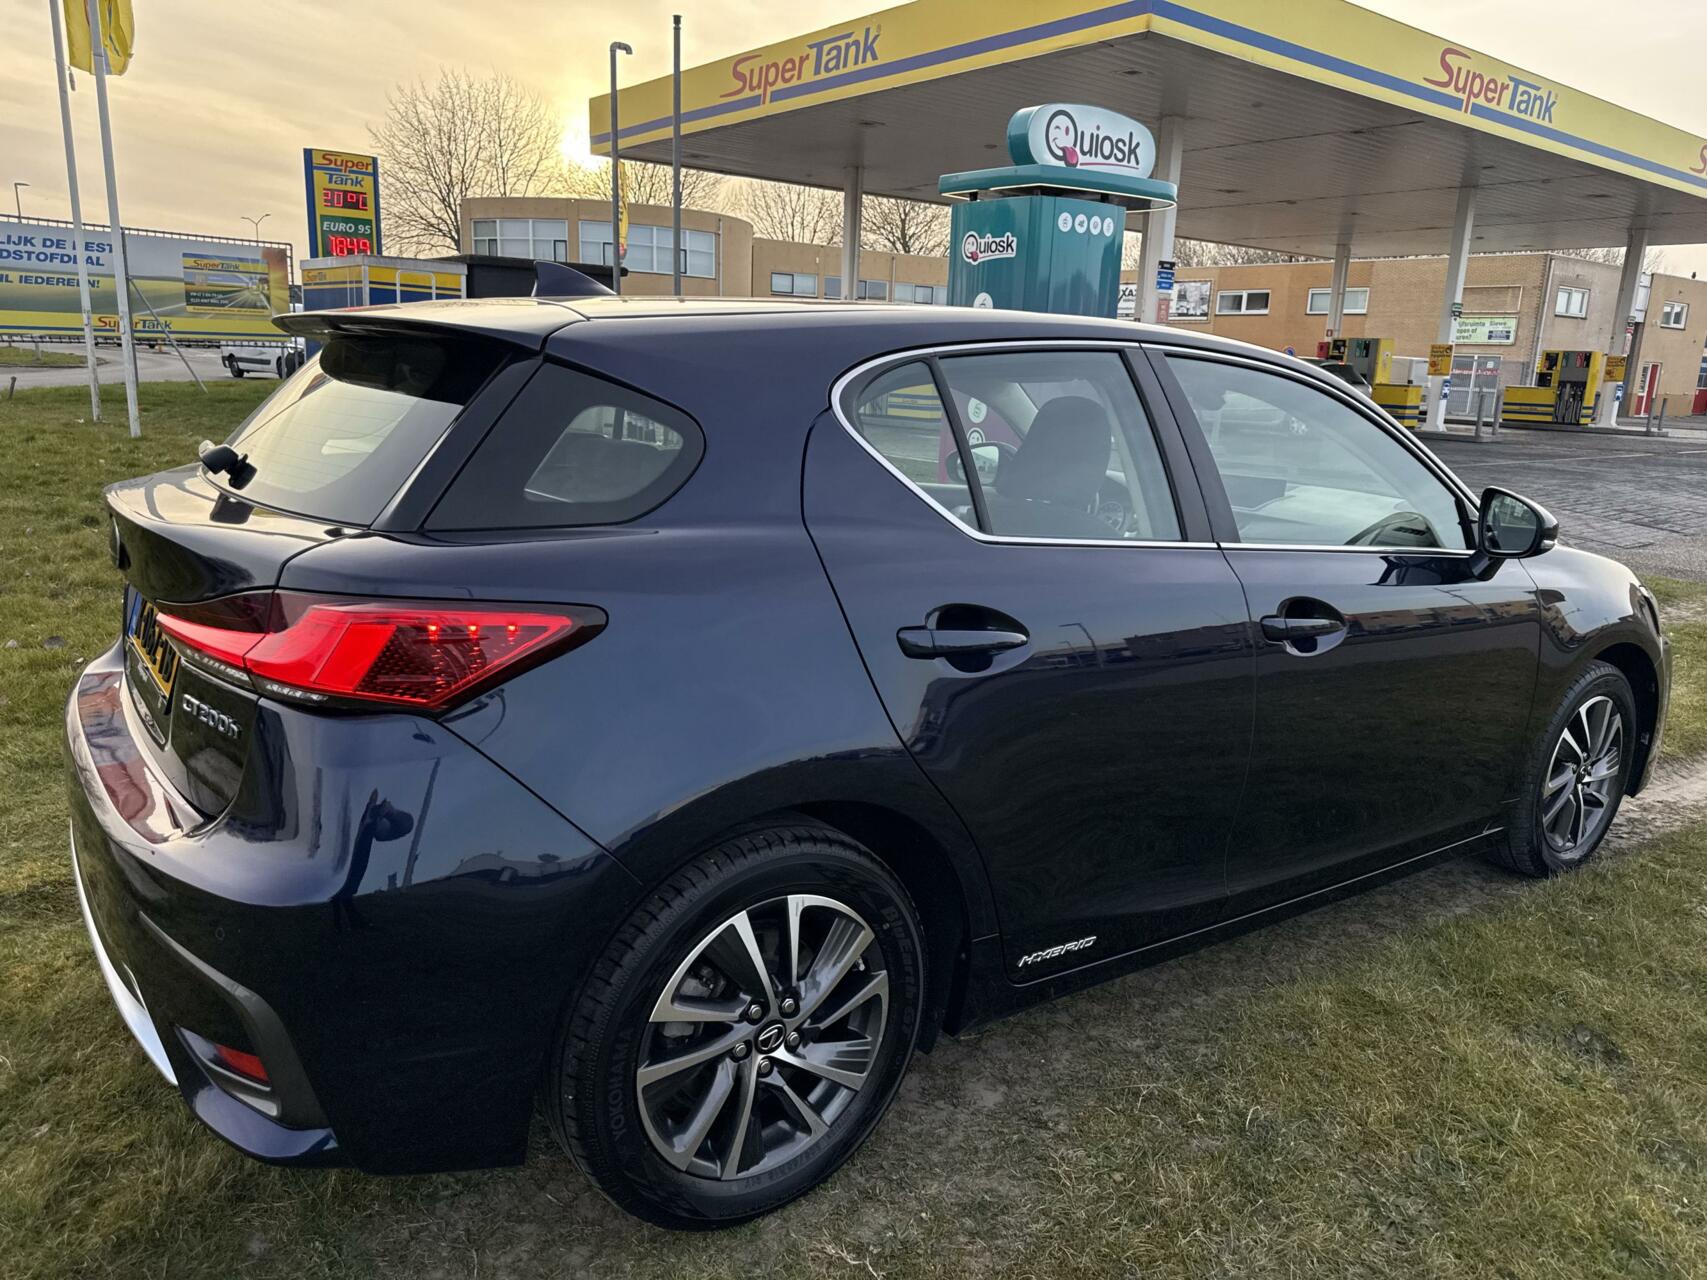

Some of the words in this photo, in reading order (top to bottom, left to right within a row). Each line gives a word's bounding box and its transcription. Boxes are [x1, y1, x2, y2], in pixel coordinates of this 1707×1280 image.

[719, 26, 881, 105] SuperTank
[1422, 46, 1558, 124] SuperTank
[1044, 109, 1141, 167] Quiosk
[316, 153, 372, 174] Super
[323, 172, 365, 188] Tank
[322, 221, 355, 233] EURO
[358, 224, 371, 234] 95
[42, 238, 67, 250] DE
[963, 233, 1015, 261] Quiosk
